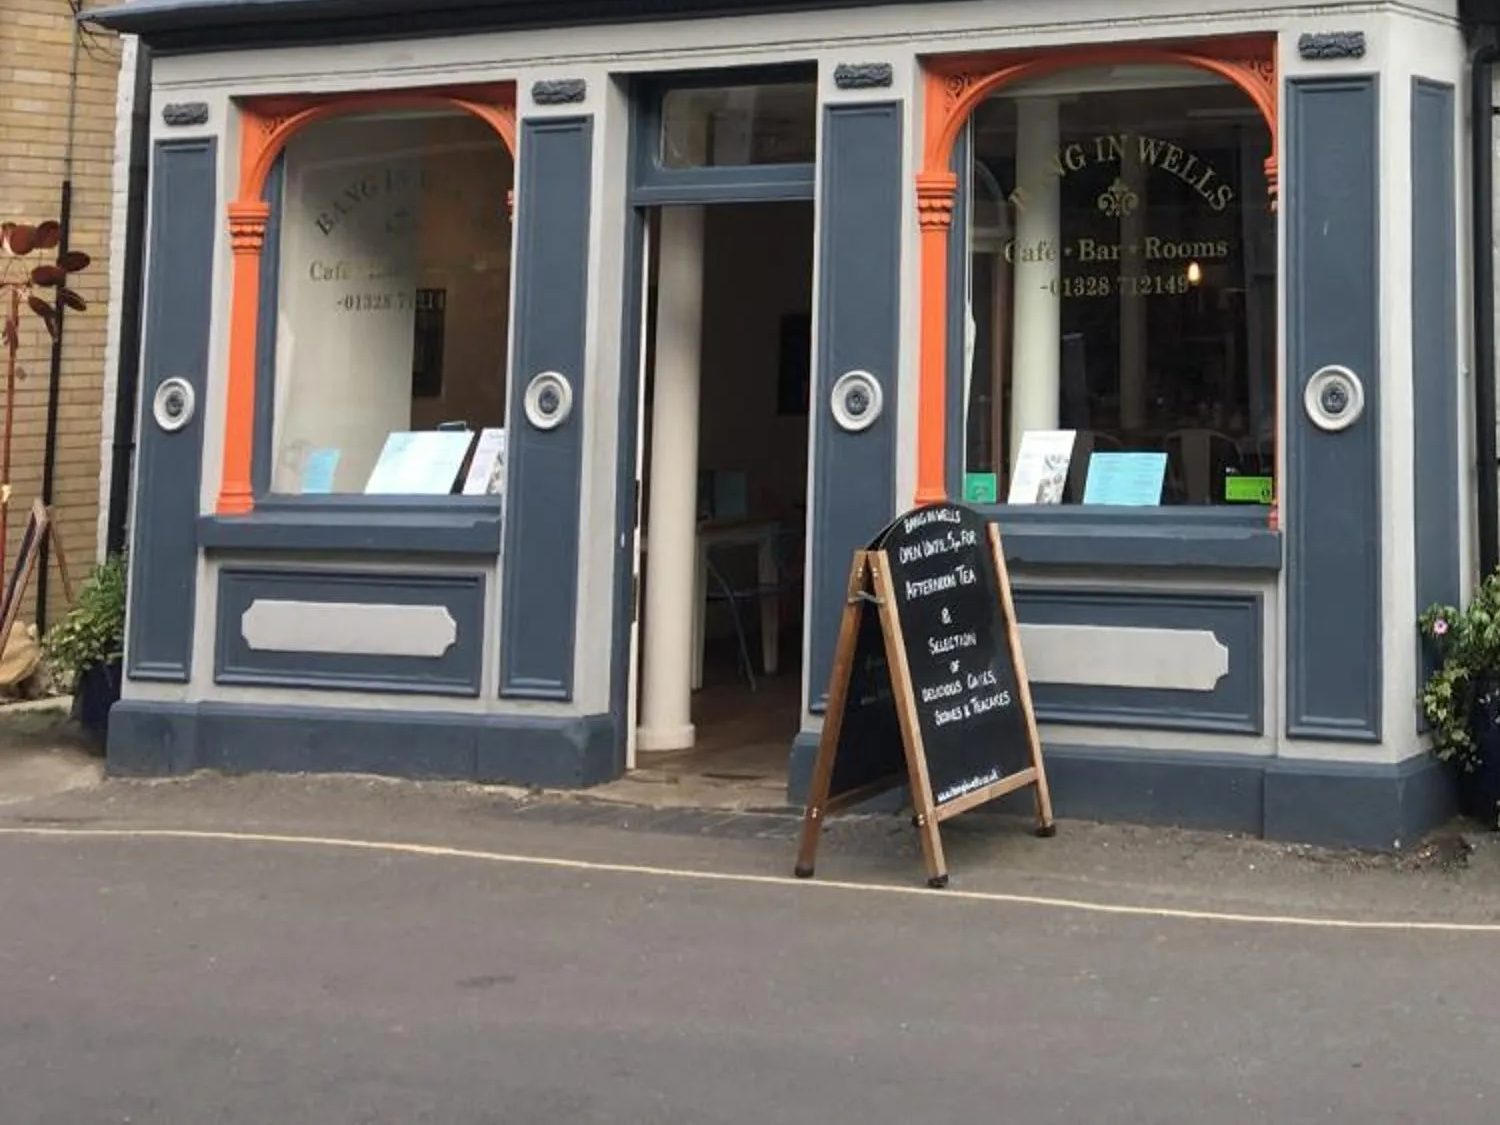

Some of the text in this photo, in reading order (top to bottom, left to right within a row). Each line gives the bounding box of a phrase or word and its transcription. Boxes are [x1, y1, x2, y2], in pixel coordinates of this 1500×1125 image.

[1096, 135, 1127, 163] IN
[1137, 135, 1234, 213] WELLS
[1079, 239, 1121, 262] Bar
[1144, 236, 1230, 260] Rooms
[899, 543, 922, 565] OPEN
[960, 529, 977, 547] FOR
[905, 563, 977, 601] AFTERNOON TEA
[941, 607, 952, 625] &
[928, 631, 977, 656] SELECTION
[922, 679, 963, 703] DELICIOUS
[970, 690, 1011, 714] TEACAKES
